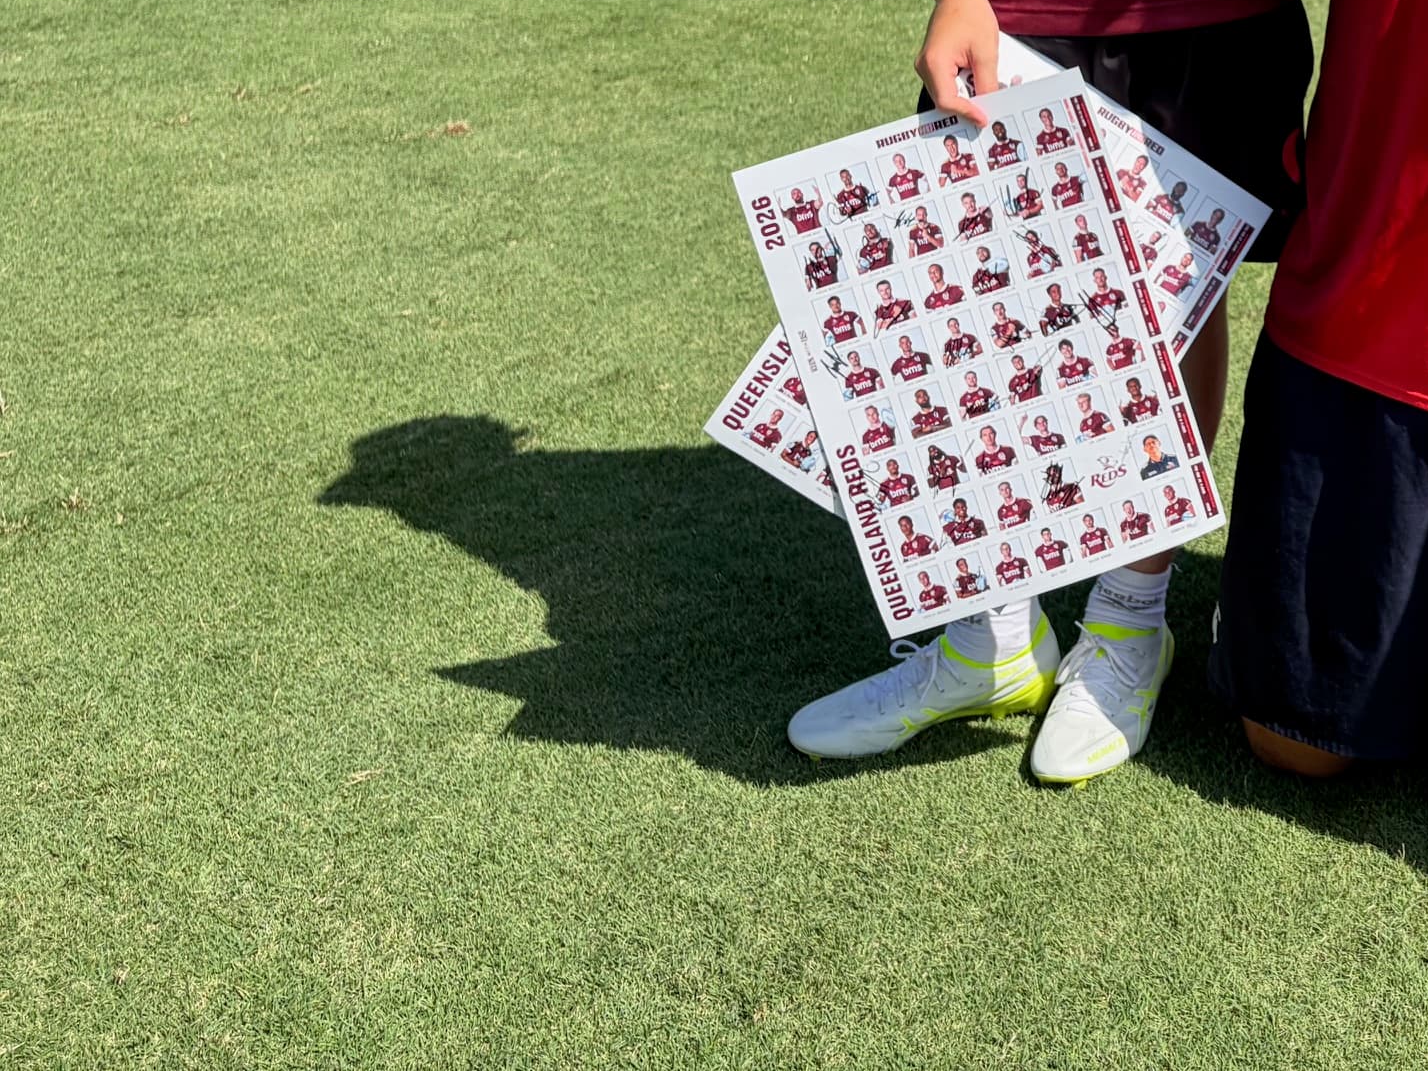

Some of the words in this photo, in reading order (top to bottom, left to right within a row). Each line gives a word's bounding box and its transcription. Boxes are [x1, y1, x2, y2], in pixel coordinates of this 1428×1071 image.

[751, 195, 786, 251] 2026
[836, 444, 869, 499] REDS
[855, 499, 915, 621] QUEENSLAND
